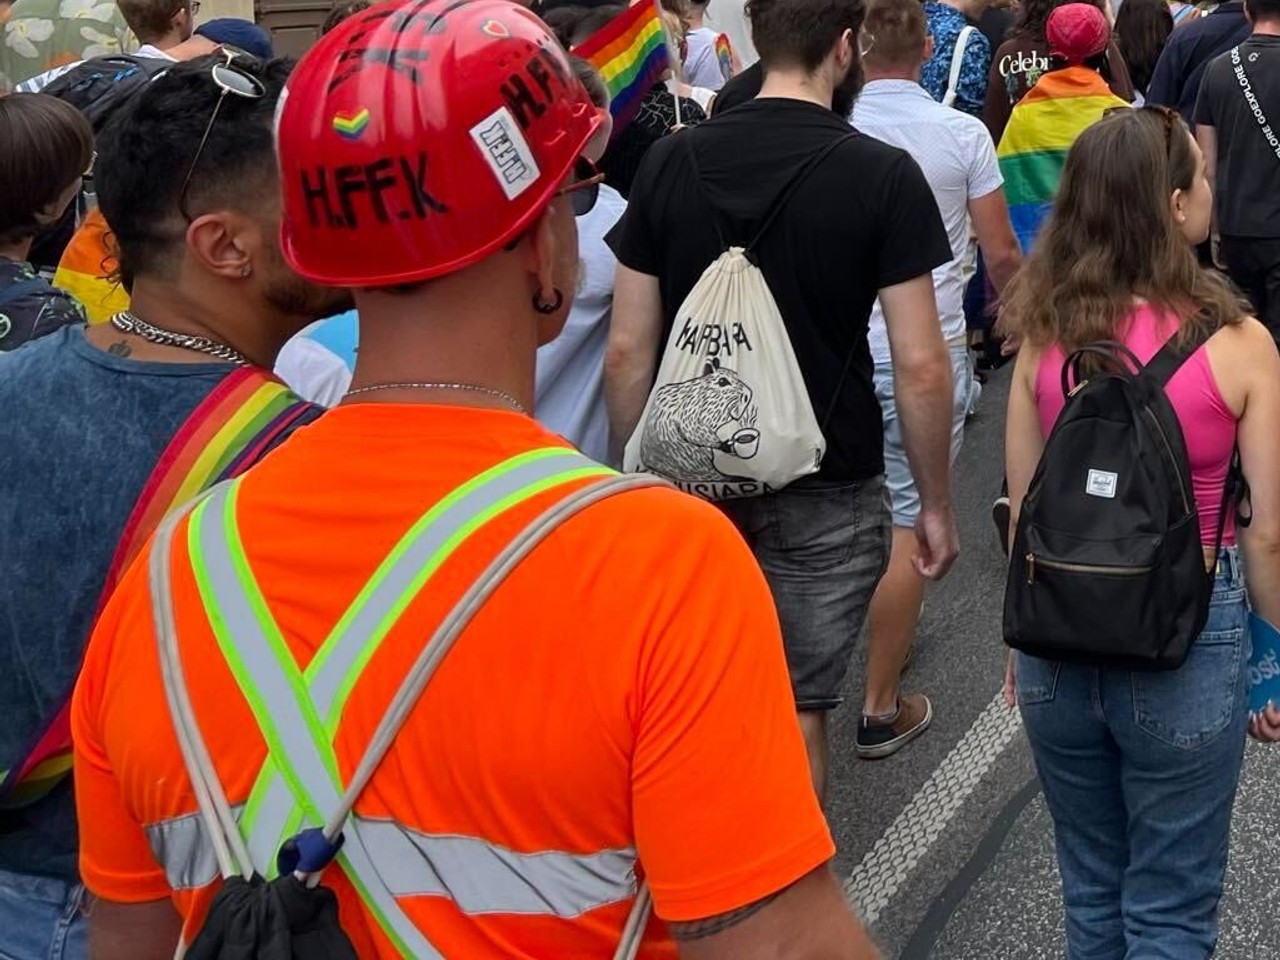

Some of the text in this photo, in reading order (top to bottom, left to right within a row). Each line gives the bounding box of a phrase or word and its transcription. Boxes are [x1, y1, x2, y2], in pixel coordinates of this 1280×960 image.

[1000, 50, 1053, 77] Celebr
[1231, 45, 1241, 64] GOE
[1233, 64, 1266, 125] GOEXPLORE
[675, 317, 752, 356] KAPBARA
